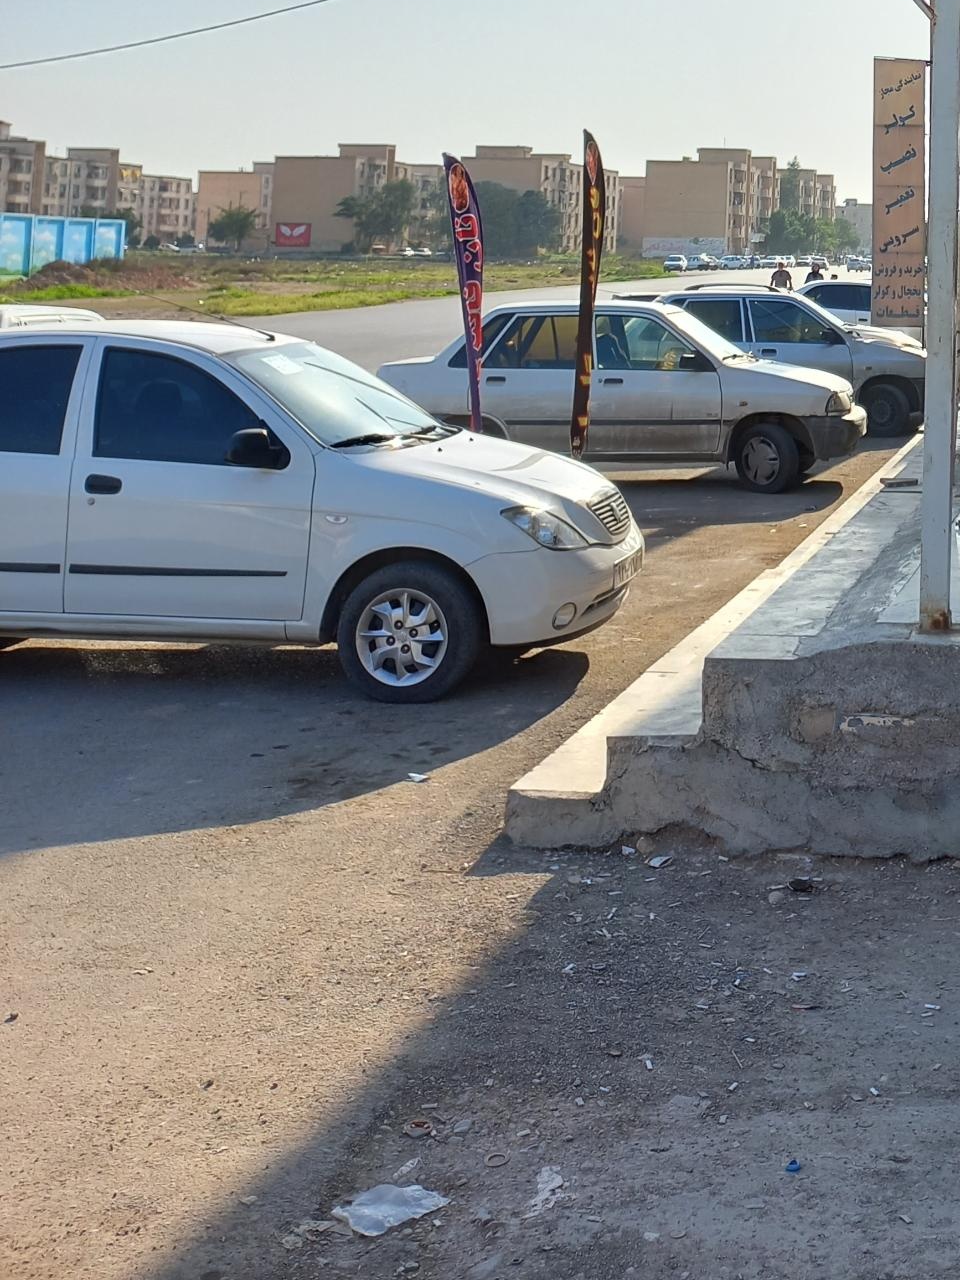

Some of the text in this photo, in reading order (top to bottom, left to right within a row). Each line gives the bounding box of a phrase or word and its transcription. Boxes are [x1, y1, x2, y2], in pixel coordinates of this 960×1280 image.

[885, 104, 916, 135] کولر
[880, 143, 917, 175] نصب
[885, 185, 915, 215] تعمیر
[879, 225, 920, 252] سرویس
[874, 262, 897, 278] فروش
[903, 264, 923, 278] خرید
[873, 284, 890, 300] کولر
[877, 305, 920, 319] قطعات
